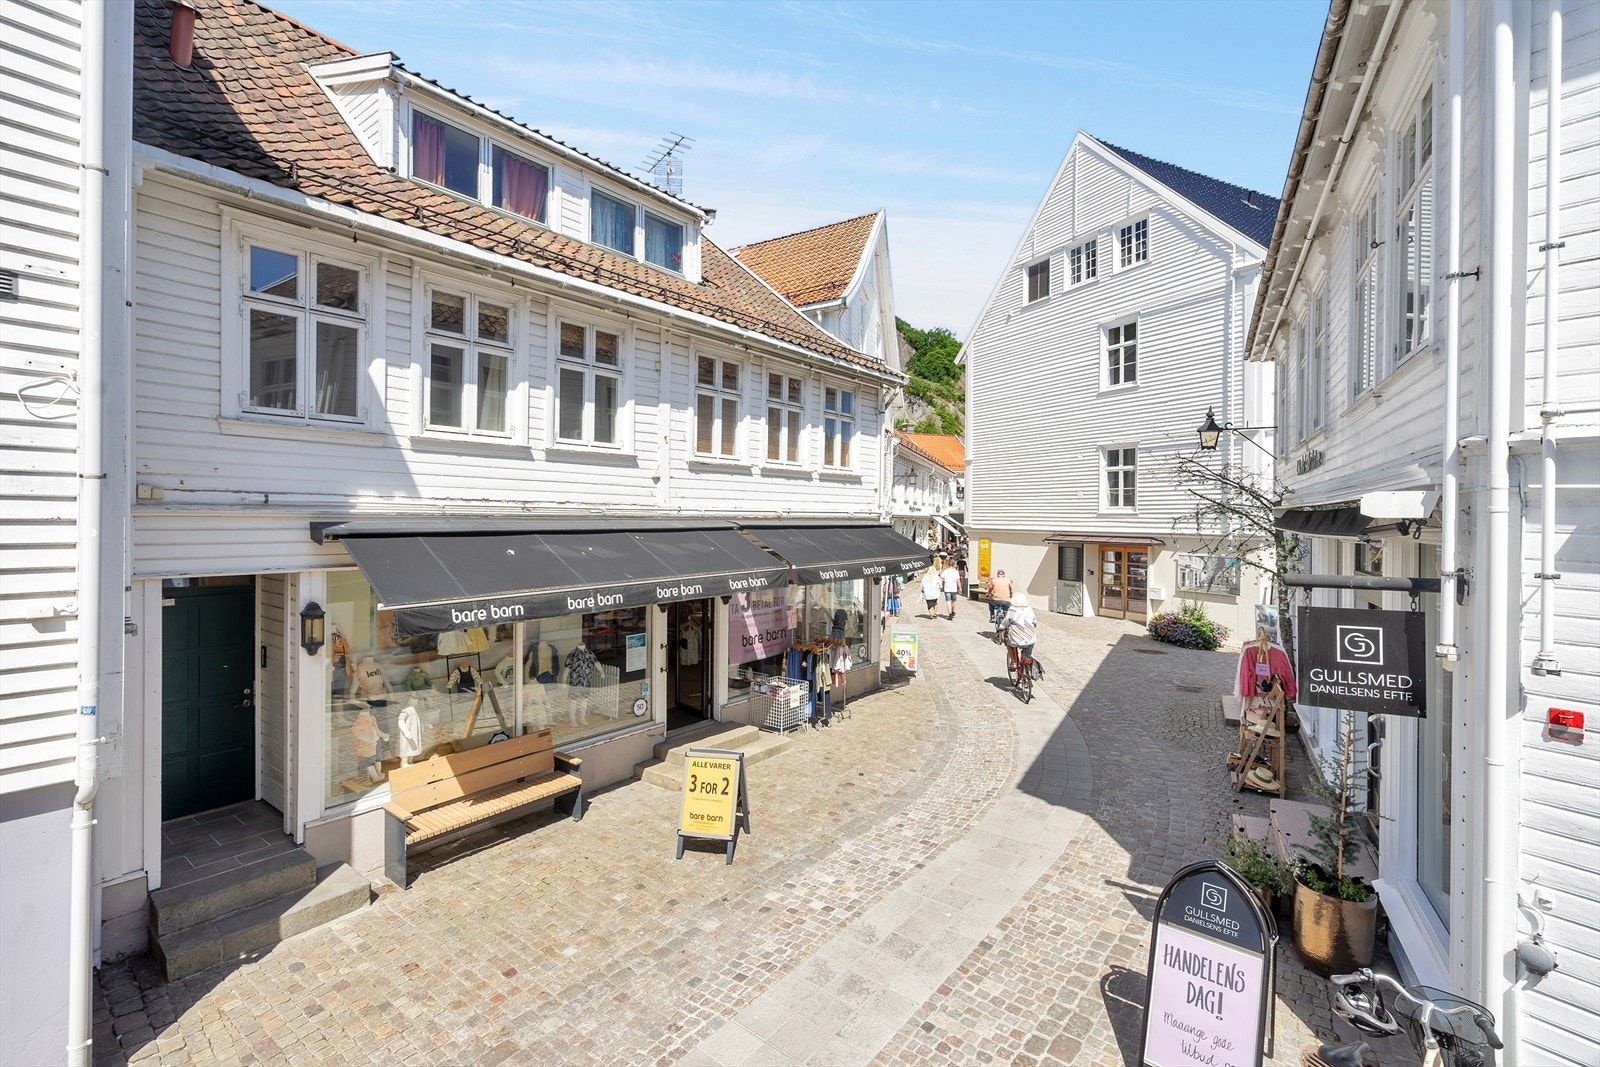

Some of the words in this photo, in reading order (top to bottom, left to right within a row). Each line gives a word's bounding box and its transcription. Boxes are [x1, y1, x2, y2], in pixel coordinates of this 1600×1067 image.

[819, 570, 834, 579] bare
[834, 569, 848, 577] barn
[862, 566, 874, 575] bare
[874, 565, 886, 573] barn
[900, 562, 912, 570] bare
[656, 586, 679, 598] bare
[680, 584, 702, 595] barn
[729, 579, 748, 589] bare
[748, 577, 767, 587] barn
[567, 597, 595, 609] bare
[597, 593, 623, 606] barn
[731, 604, 739, 614] TA
[741, 592, 750, 612] 3
[752, 599, 771, 610] BETAL
[773, 597, 784, 607] FOR
[451, 608, 487, 623] bare
[490, 604, 524, 618] barn
[742, 633, 763, 647] bare
[766, 629, 787, 641] barn
[1310, 668, 1413, 688] GULLSMED
[1310, 683, 1380, 699] DANIELSENS
[692, 760, 708, 768] ALLE
[709, 762, 731, 770] VARER
[689, 774, 697, 792] 3
[700, 782, 718, 794] FOR
[720, 777, 730, 796] 2
[689, 812, 705, 820] bare
[706, 813, 723, 822] barn
[1184, 914, 1223, 934] DANIELSENS
[1185, 905, 1240, 930] GULLSMED
[1163, 943, 1246, 993] HANDELENS
[1186, 981, 1223, 1021] DAG!
[1163, 1011, 1207, 1043] Maaange
[1211, 1035, 1234, 1051] gode
